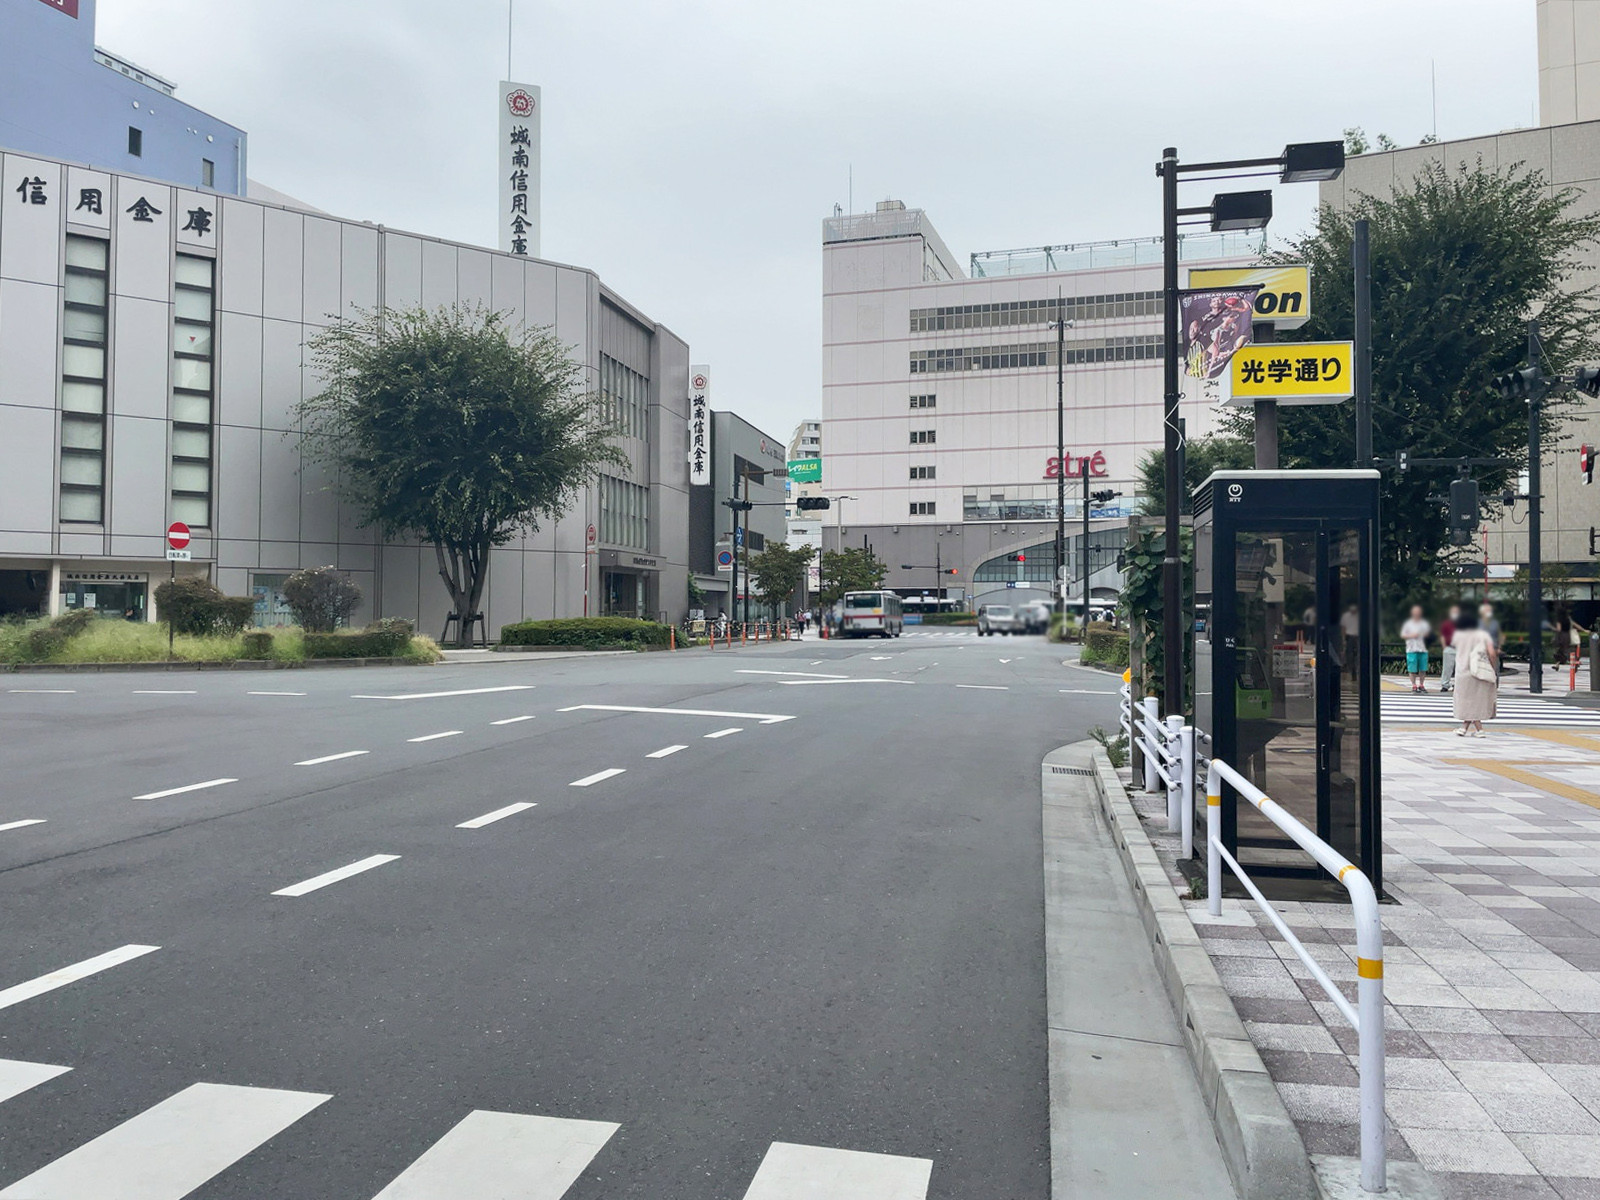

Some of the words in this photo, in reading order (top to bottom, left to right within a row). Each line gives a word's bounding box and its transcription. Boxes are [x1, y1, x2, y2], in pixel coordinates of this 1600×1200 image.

[16, 175, 213, 237] 信用金庫
[510, 125, 532, 255] 城南信用金庫
[1241, 357, 1342, 384] 光学通り
[693, 395, 707, 476] 城南信用金庫
[1046, 450, 1107, 477] atré
